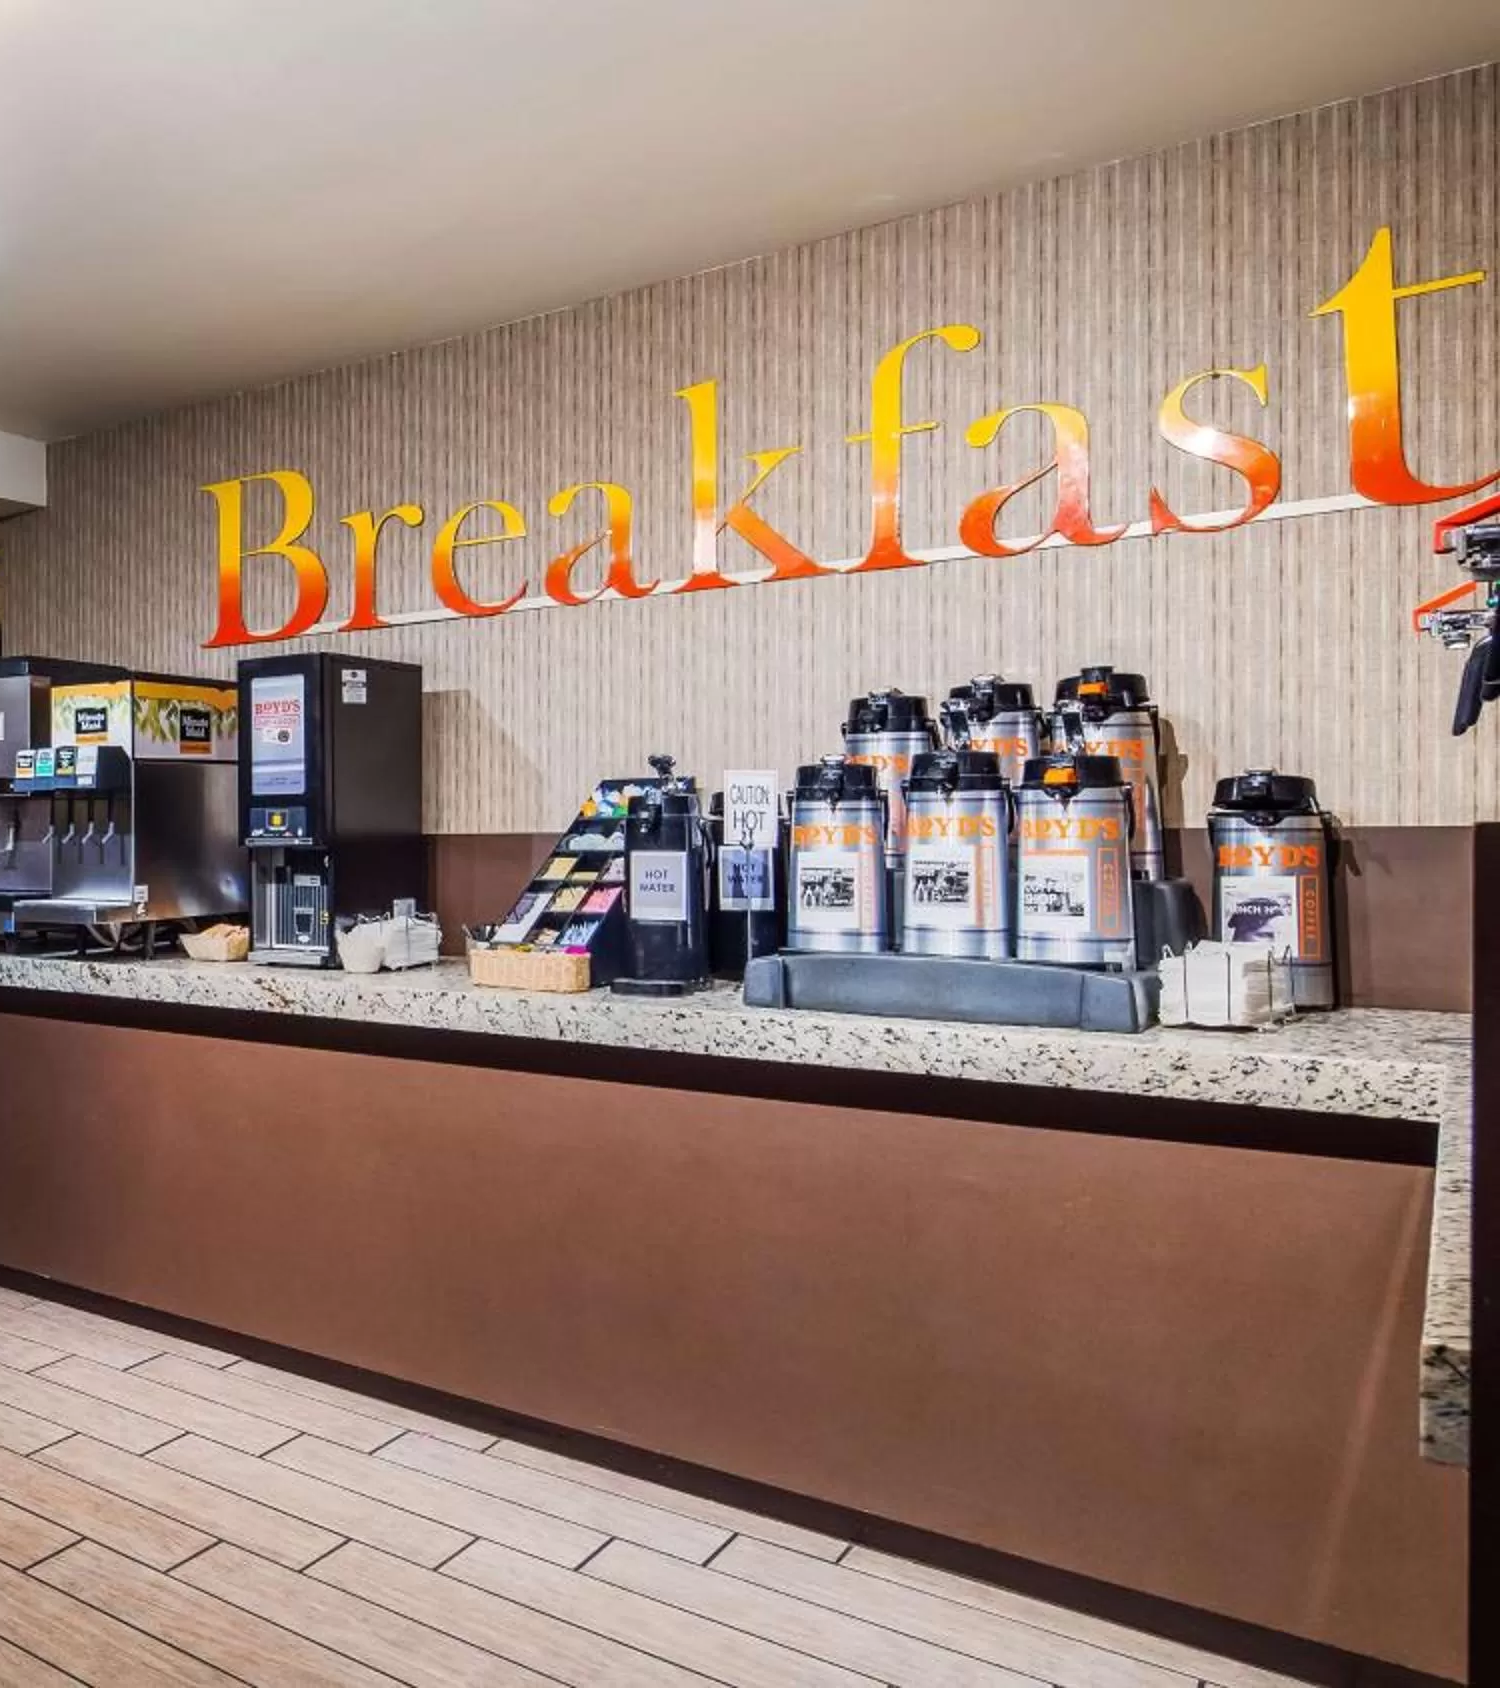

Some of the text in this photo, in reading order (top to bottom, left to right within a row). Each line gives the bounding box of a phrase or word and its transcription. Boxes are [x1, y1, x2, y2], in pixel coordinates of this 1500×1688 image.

[200, 225, 1500, 648] Breakfast
[730, 784, 770, 805] CAUTION
[733, 810, 767, 831] HOT
[645, 869, 668, 879] HOT
[639, 883, 676, 893] WATER
